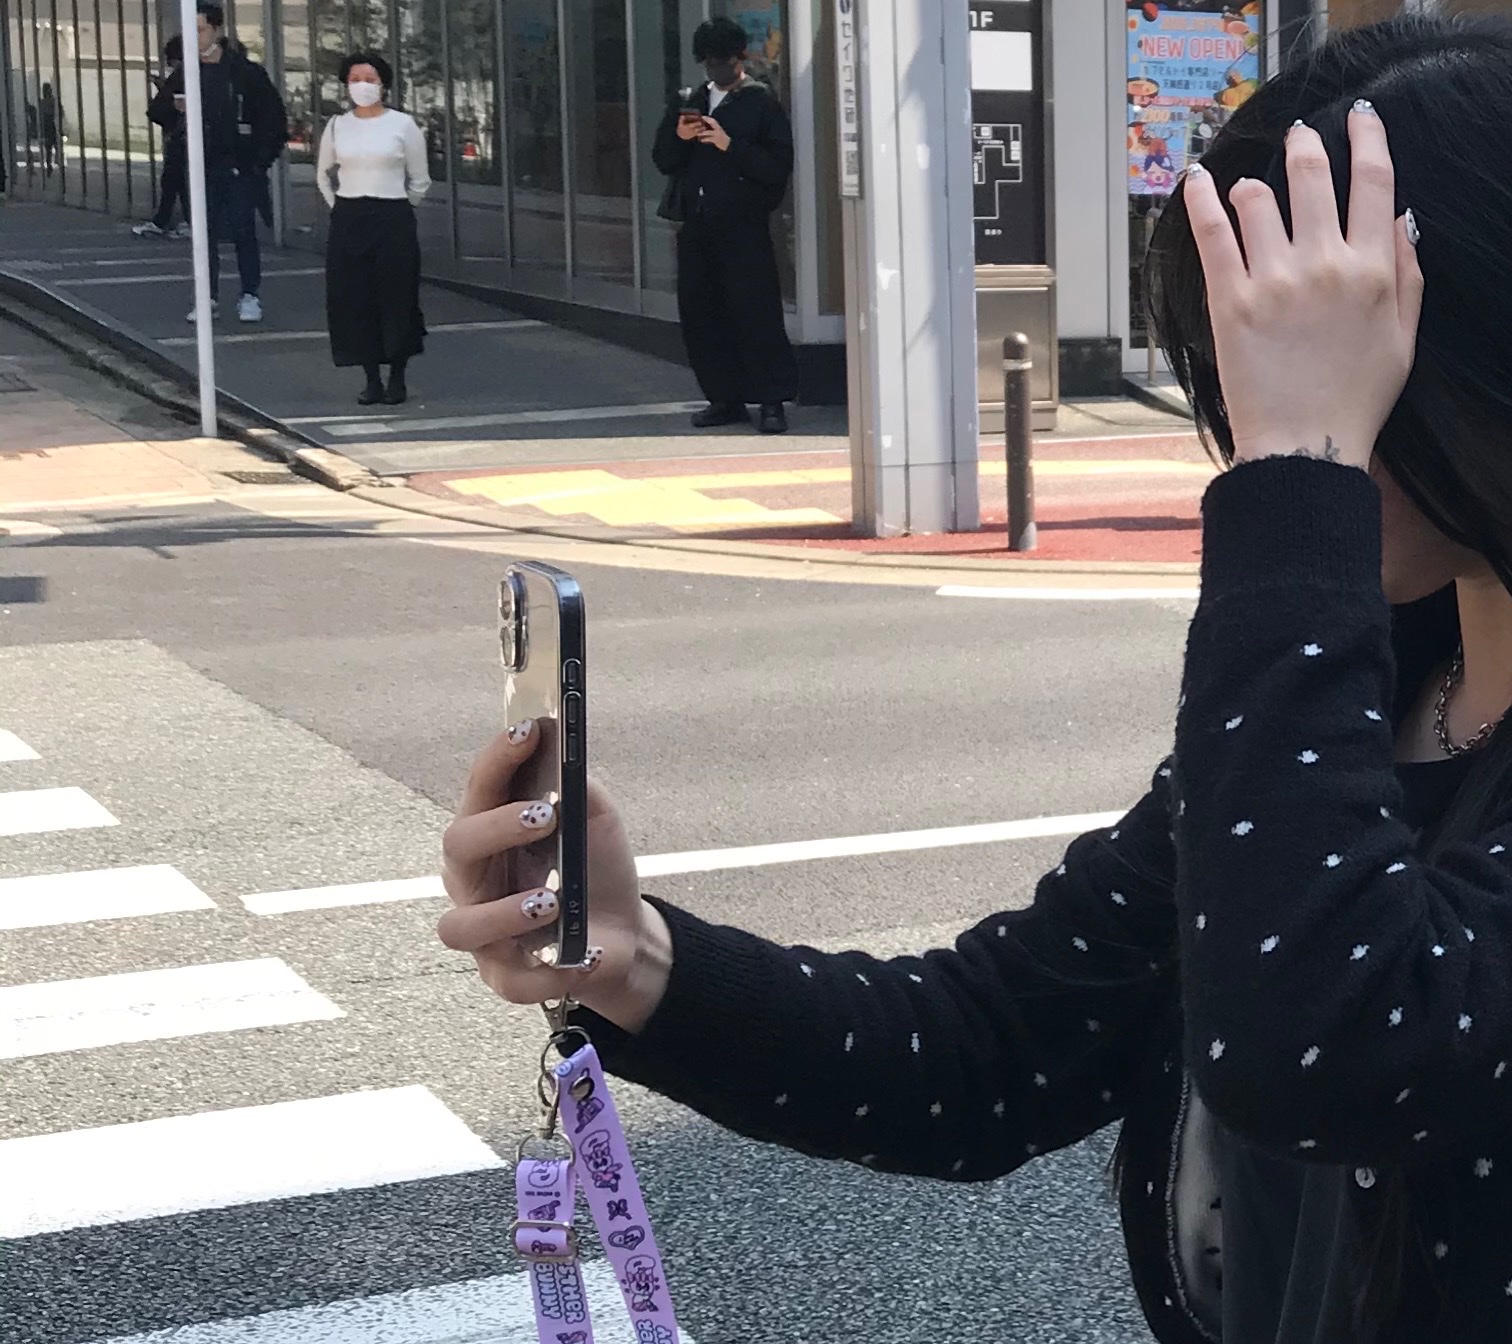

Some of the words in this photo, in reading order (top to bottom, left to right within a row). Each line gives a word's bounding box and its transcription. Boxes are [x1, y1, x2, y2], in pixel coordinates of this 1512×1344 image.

[969, 10, 993, 27] 1F
[1143, 36, 1185, 58] NEW
[1189, 37, 1244, 61] OPEN!
[533, 1262, 562, 1319] BUNNY
[556, 1261, 586, 1324] STHER
